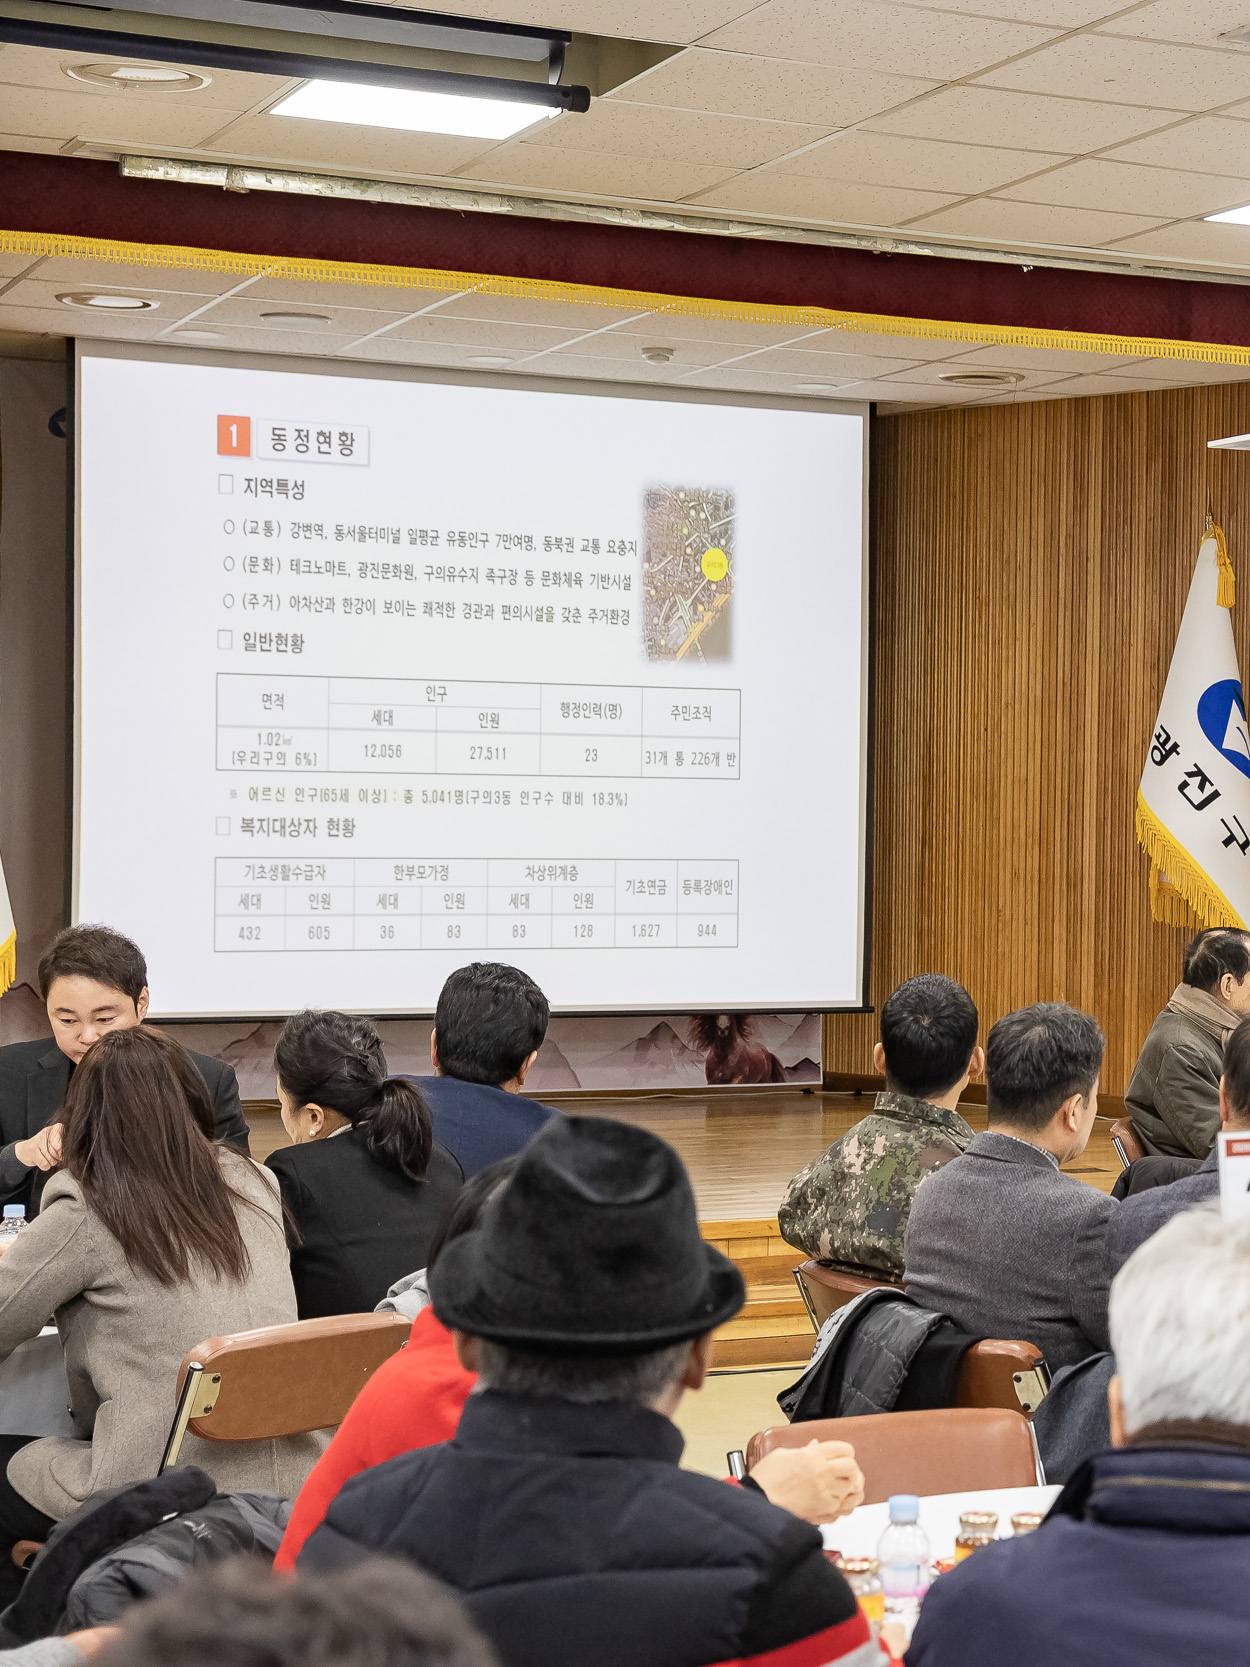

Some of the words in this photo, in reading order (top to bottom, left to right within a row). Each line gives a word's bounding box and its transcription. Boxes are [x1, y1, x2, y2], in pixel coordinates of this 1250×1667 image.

[229, 423, 238, 447] 1
[271, 426, 355, 457] 동정현황
[243, 476, 305, 500] 지역특성
[243, 518, 281, 538] (교통)
[290, 521, 328, 541] 강변역,
[334, 524, 401, 545] 동서울터미널
[408, 528, 440, 547] 일평균
[446, 530, 490, 549] 유동인구
[495, 533, 537, 552] 7만여명,
[543, 535, 575, 554] 동북권
[580, 538, 601, 555] 교통
[606, 539, 638, 557] 요충지
[243, 555, 281, 575] (문화)
[290, 558, 351, 578] 테크노마트,
[357, 561, 417, 581] 광진문화원,
[423, 565, 479, 584] 구의유수지
[485, 567, 518, 586] 족구장
[524, 569, 535, 587] 등
[541, 570, 584, 589] 문화체육
[589, 573, 632, 591] 기반시설
[243, 593, 281, 611] (주거)
[289, 595, 336, 614] 아차산과
[342, 597, 376, 615] 한강이
[383, 599, 417, 617] 보이는
[422, 601, 456, 619] 쾌적한
[462, 602, 494, 620] 경관과
[501, 604, 556, 623] 편의시설을
[561, 606, 582, 624] 갖춘
[588, 608, 630, 626] 주거환경
[243, 631, 305, 654] 일반현황
[261, 692, 285, 711] 면적
[425, 684, 448, 702] 인구
[371, 709, 394, 727] 세대
[560, 702, 623, 720] 행정인력(명)
[671, 705, 712, 722] 주민조직
[478, 712, 500, 729] 인원
[585, 748, 598, 762] 23
[645, 751, 668, 766] 31개
[674, 751, 684, 767] 통
[691, 752, 720, 767] 226개
[726, 752, 736, 768] 반
[248, 787, 285, 802] 어르신
[520, 791, 554, 806] 인구수
[563, 791, 584, 806] 대비
[1150, 724, 1250, 856] 광진구
[240, 817, 318, 838] 복지대상자
[327, 817, 356, 839] 현황
[244, 864, 326, 882] 기초생활수급자
[393, 864, 450, 881] 한부모가정
[524, 864, 579, 882] 차상위계층
[625, 879, 668, 896] 기초연금
[682, 879, 733, 896] 등록장애인
[238, 893, 262, 911] 세대
[308, 893, 331, 911] 인원
[376, 893, 399, 910] 세대
[443, 893, 466, 910] 인원
[508, 893, 530, 910] 세대
[573, 893, 594, 910] 인원
[238, 926, 262, 940] 432
[308, 926, 331, 940] 605
[380, 925, 395, 939] 36
[512, 924, 526, 938] 83
[573, 924, 593, 938] 128
[697, 923, 717, 937] 944
